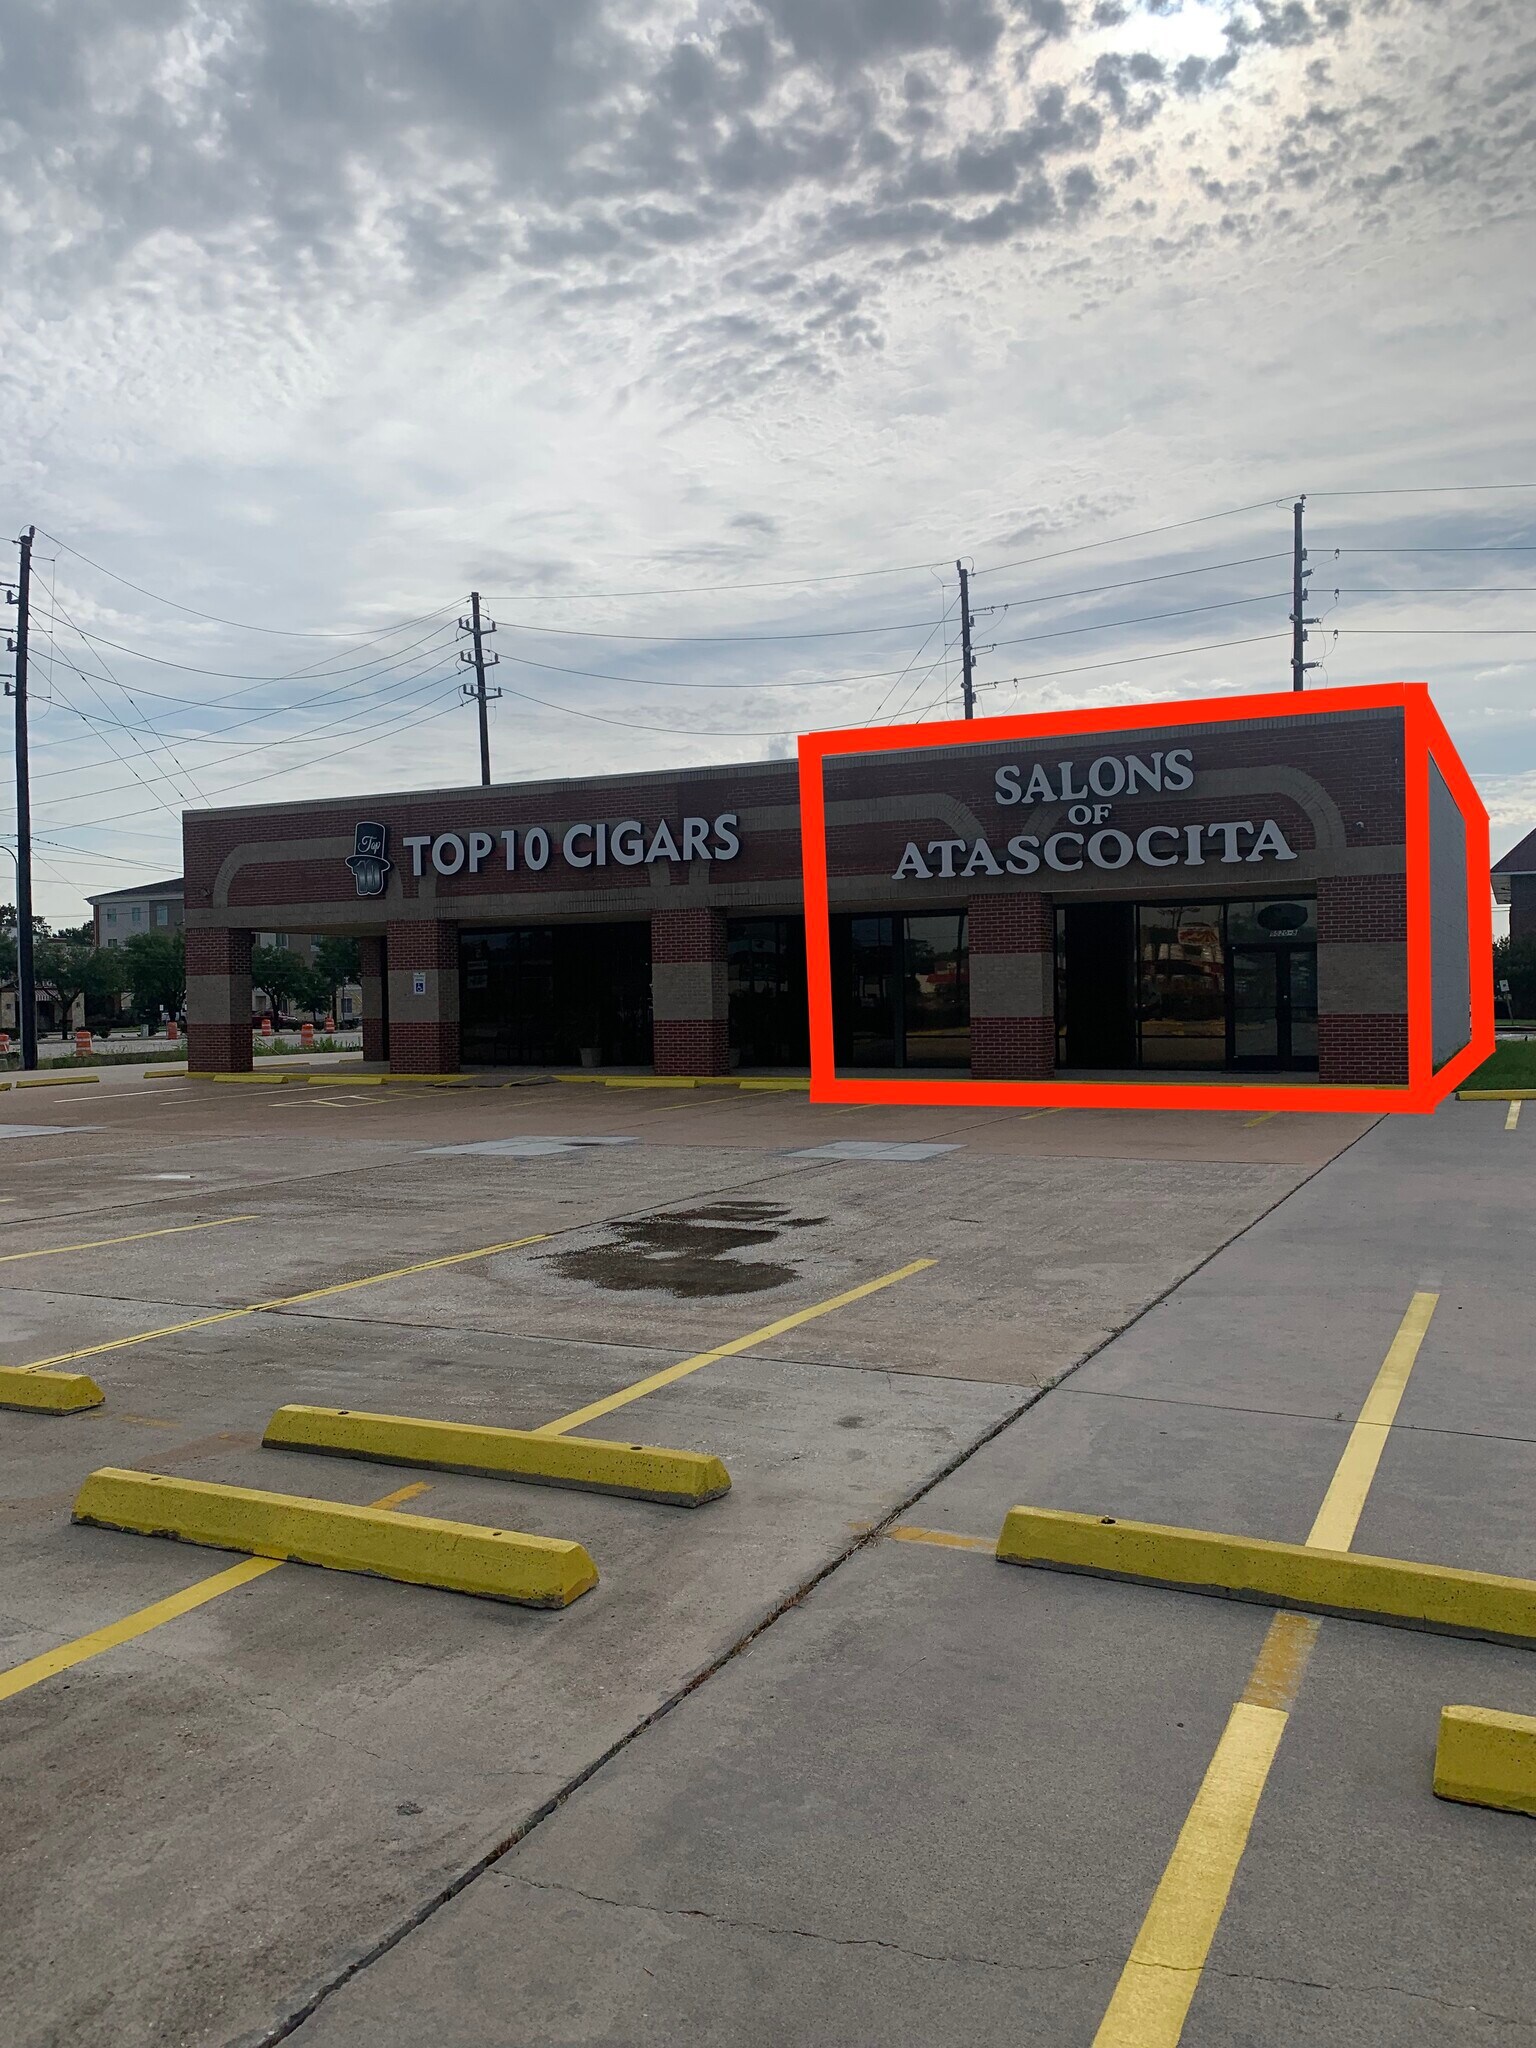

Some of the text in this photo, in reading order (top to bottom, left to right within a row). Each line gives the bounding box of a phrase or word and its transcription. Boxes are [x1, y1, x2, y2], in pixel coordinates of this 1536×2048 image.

[995, 749, 1194, 805] SALONS
[1068, 804, 1112, 826] OF
[358, 836, 381, 854] Top
[403, 814, 740, 876] TOP 10 CIGARS
[892, 819, 1298, 880] ATASCOCITA
